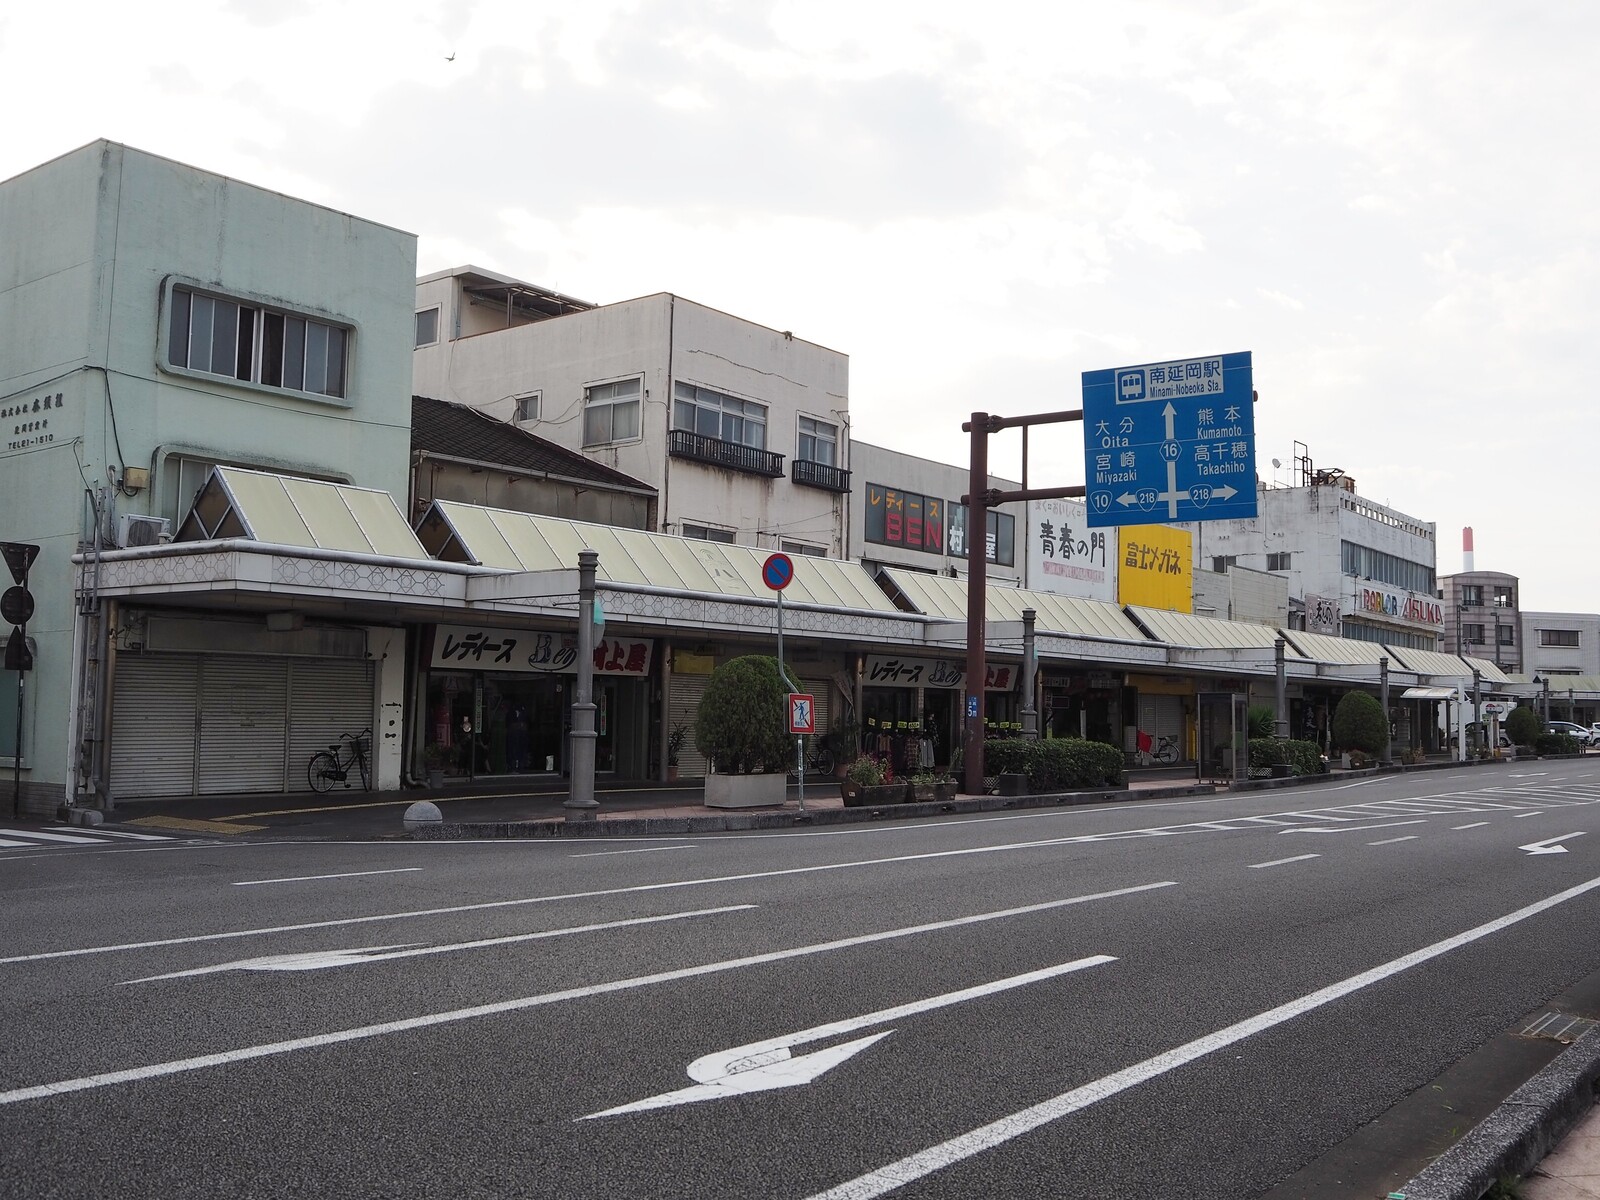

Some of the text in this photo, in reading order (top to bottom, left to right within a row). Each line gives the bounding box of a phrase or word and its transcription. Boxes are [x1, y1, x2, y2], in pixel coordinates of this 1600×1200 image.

[1149, 360, 1222, 384] 南延岡駅
[1149, 380, 1222, 399] Minami-Nobeoka Sta.
[1197, 405, 1241, 426] 熊本
[1095, 416, 1135, 437] 大分
[1197, 425, 1242, 439] Kumamoto
[1101, 436, 1129, 449] Oita
[1163, 444, 1177, 457] 16
[1194, 441, 1248, 462] 高千穂
[1095, 451, 1136, 471] 宮崎
[1197, 461, 1245, 476] Takachiho
[1096, 469, 1137, 485] Miyazaki
[870, 488, 938, 518] レディース
[1095, 494, 1108, 507] 10
[1139, 492, 1155, 504] 218
[1193, 488, 1209, 500] 218
[886, 513, 941, 548] BEN
[1039, 518, 1106, 568] 青春の門
[1125, 541, 1182, 575] 富士メガネ
[1362, 588, 1398, 616] PARLOR
[1401, 597, 1444, 625] ASUKA
[441, 631, 517, 663] レディース
[870, 659, 924, 683] レディース
